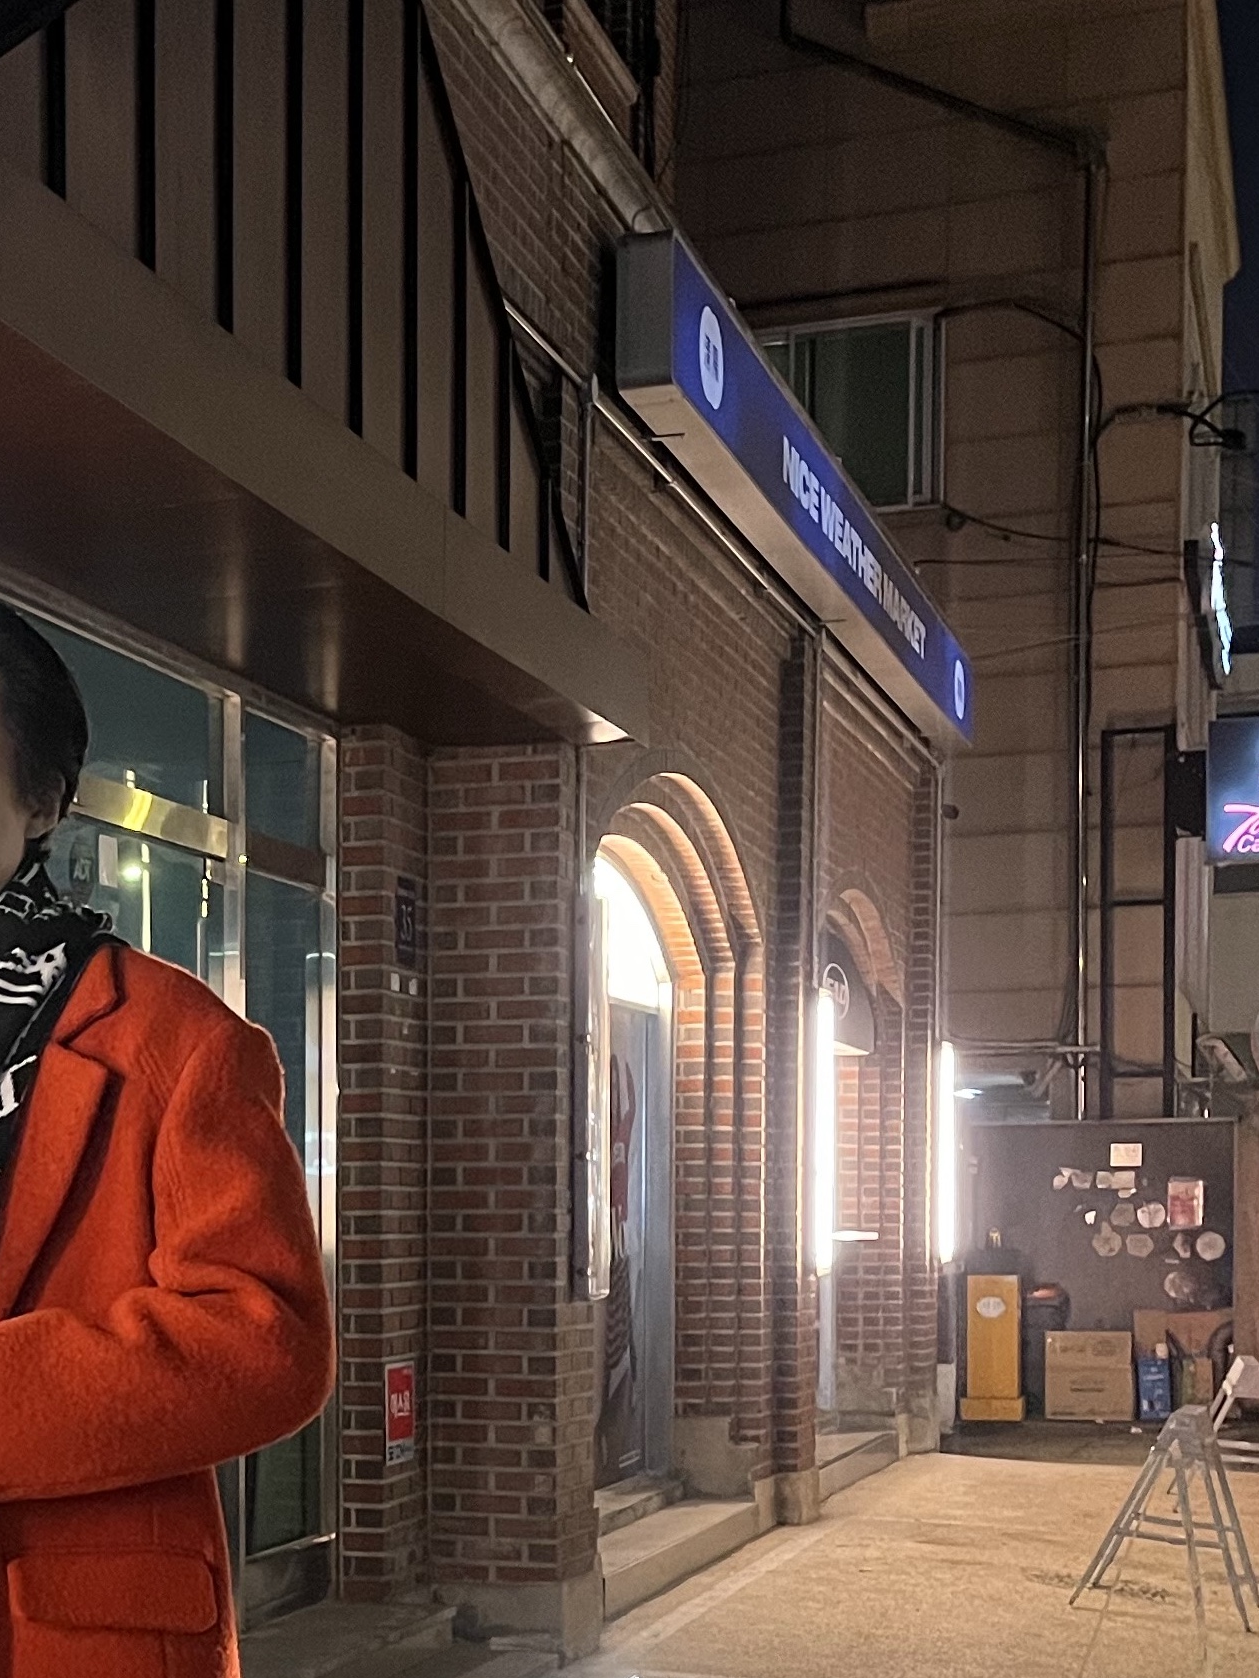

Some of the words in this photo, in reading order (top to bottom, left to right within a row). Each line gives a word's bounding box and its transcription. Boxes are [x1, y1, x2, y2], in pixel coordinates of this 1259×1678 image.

[783, 435, 819, 524] NICE
[820, 486, 882, 605] WEATHER
[883, 572, 926, 660] MARKET
